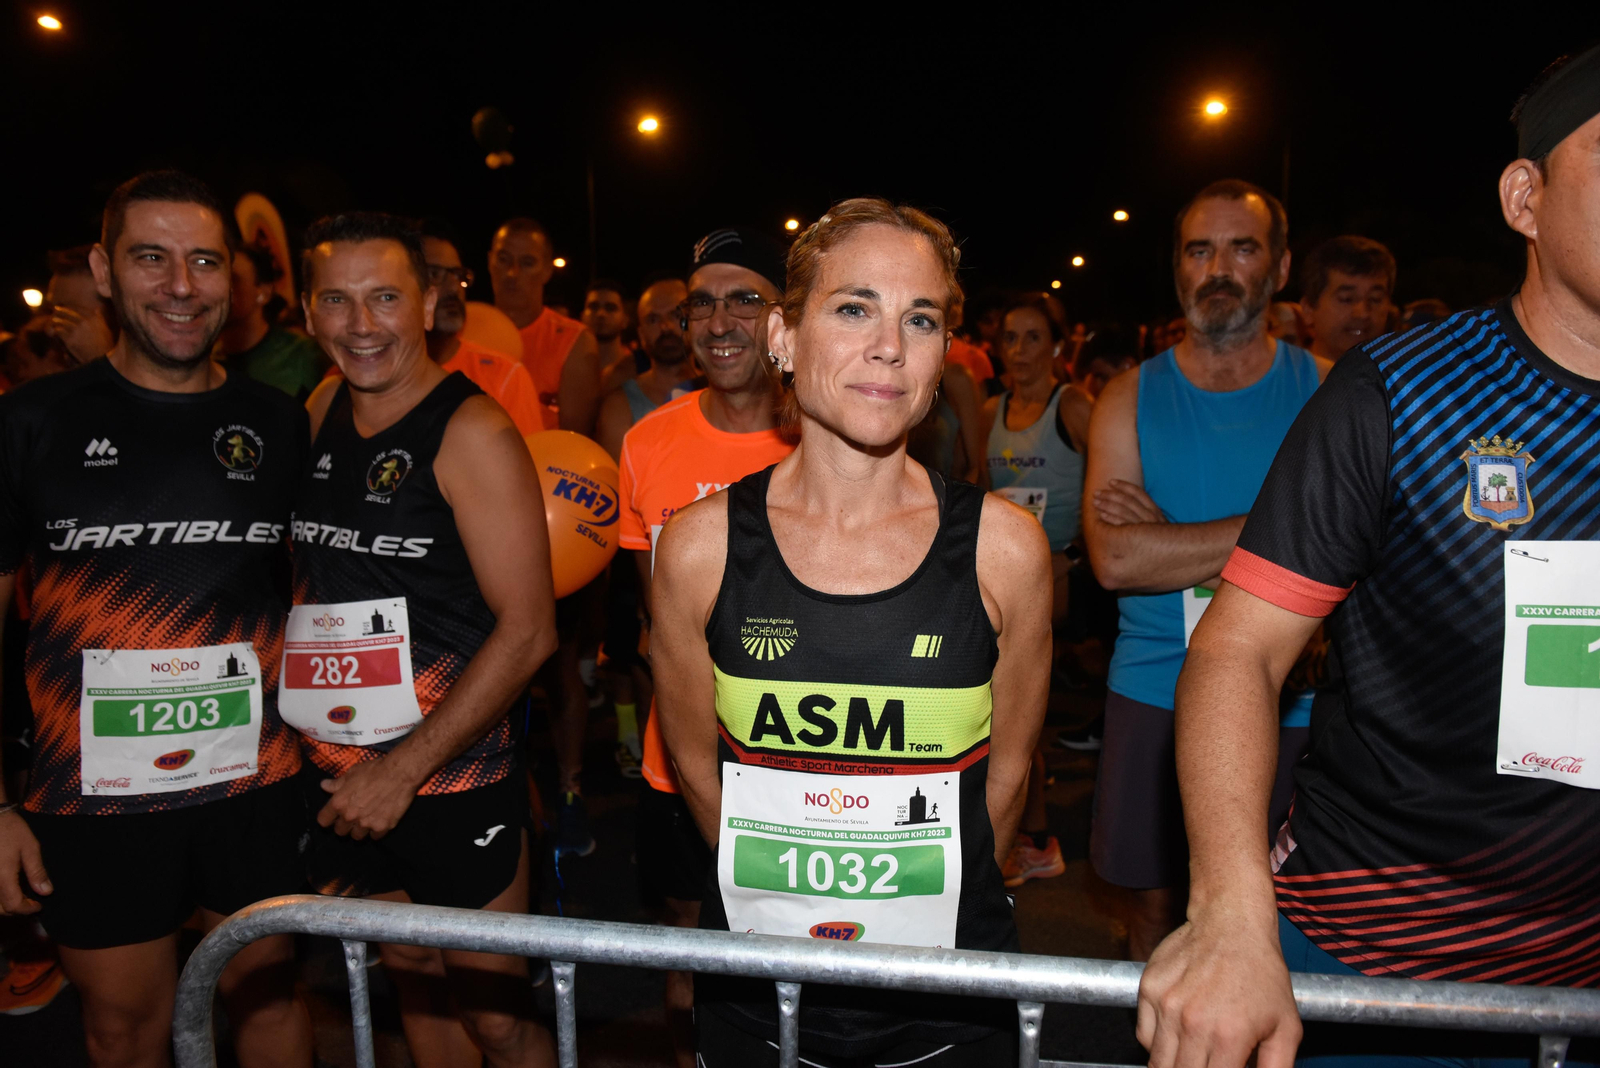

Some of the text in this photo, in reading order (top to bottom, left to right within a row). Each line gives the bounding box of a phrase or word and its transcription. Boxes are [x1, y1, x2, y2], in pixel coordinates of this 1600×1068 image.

[84, 457, 118, 467] mobel
[226, 471, 255, 481] SEVILLA
[546, 465, 601, 491] NOCTURNA
[365, 493, 391, 504] SEVILLA
[46, 518, 79, 530] LOS
[50, 520, 285, 551] JARTIBLES
[575, 523, 608, 549] SEVILLA
[1522, 607, 1553, 616] XXXV
[746, 616, 768, 624] Servicios
[741, 625, 799, 638] HACHEMUDA
[310, 655, 362, 686] 282
[138, 687, 173, 695] NOCTURNA
[129, 697, 221, 732] 1203
[374, 722, 416, 736] Cruzcampo
[749, 692, 905, 752] ASM
[908, 742, 943, 752] Team
[209, 761, 249, 775] Cruzcampo
[760, 755, 894, 775] Athletic Sport Marchena
[732, 819, 946, 841] XXXV CARRERA NOCTURNA DEL GUADALQUIVIR KH7 2023
[778, 846, 899, 894] 1032
